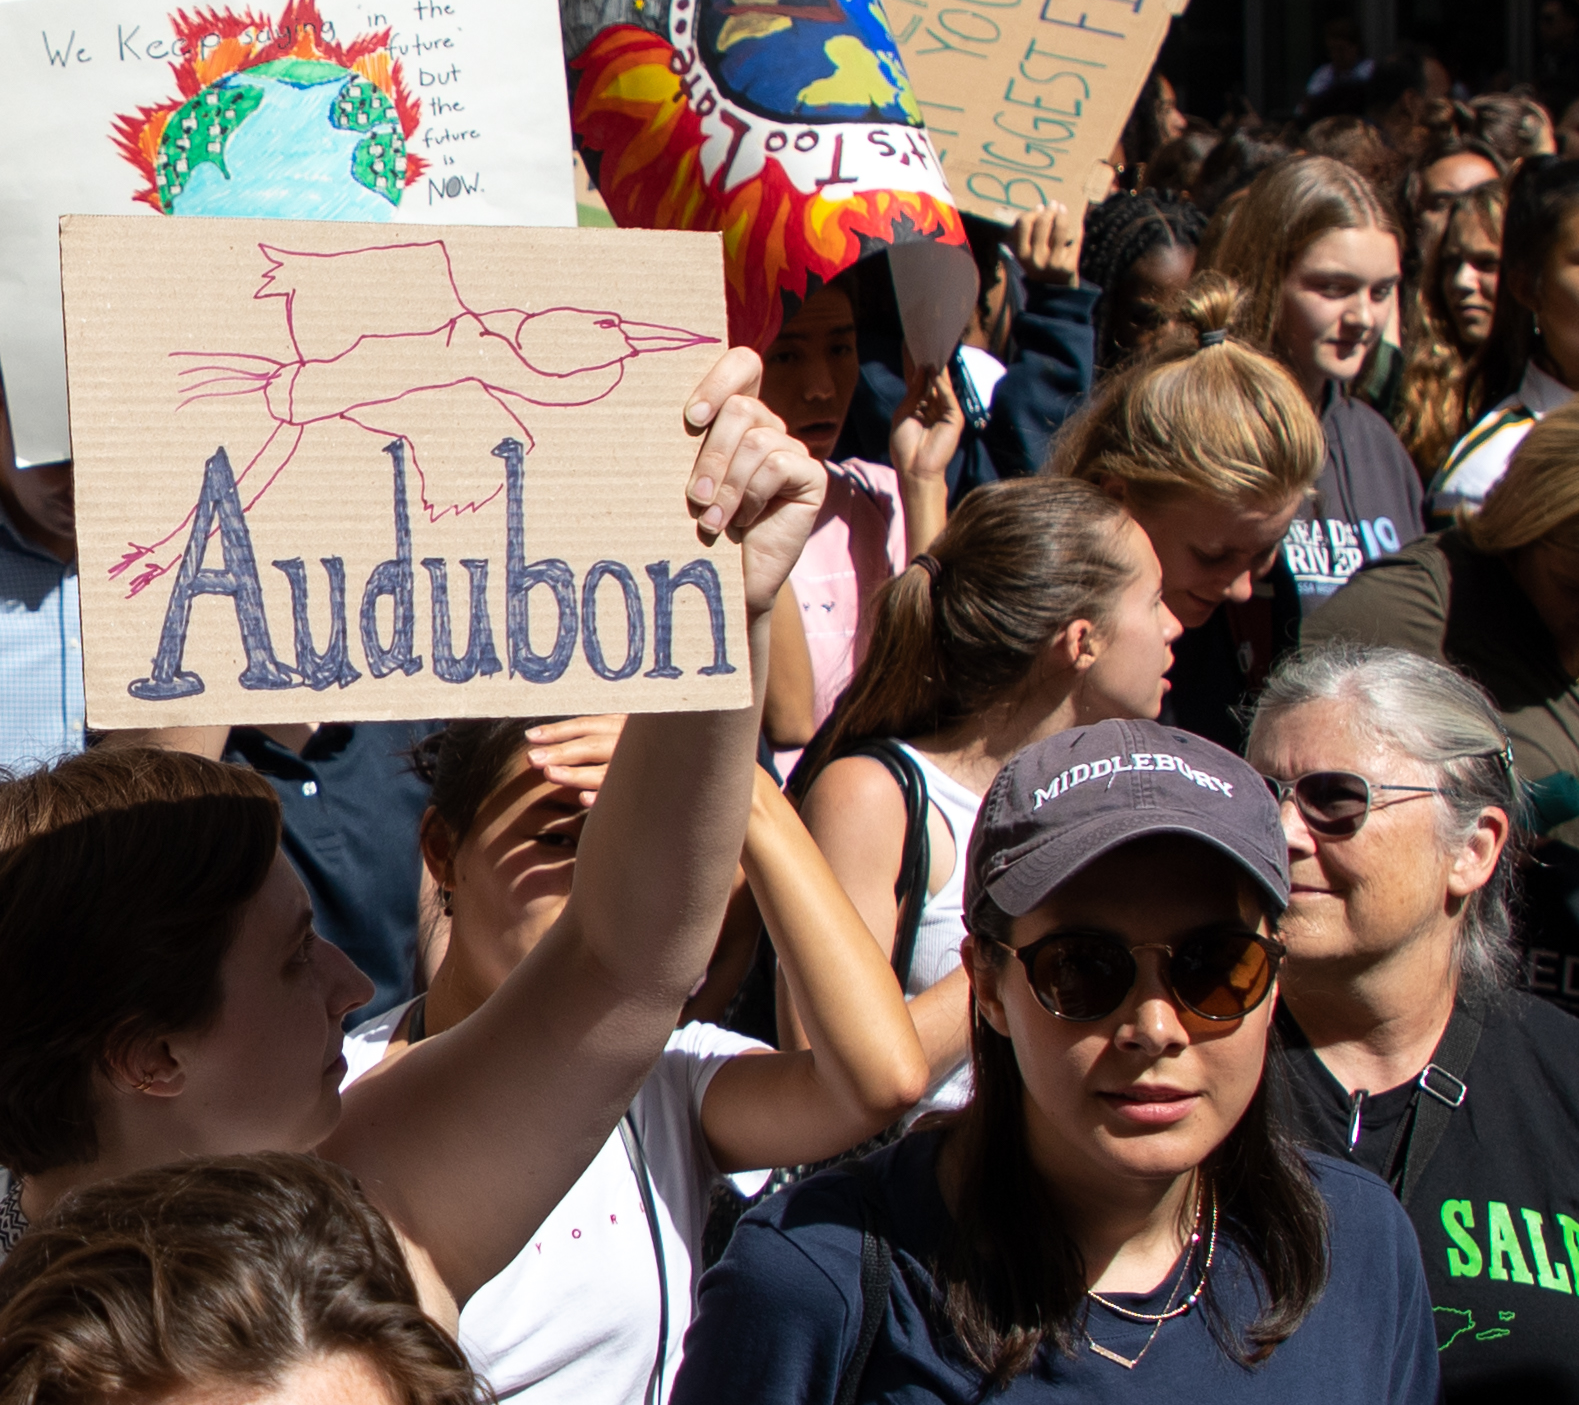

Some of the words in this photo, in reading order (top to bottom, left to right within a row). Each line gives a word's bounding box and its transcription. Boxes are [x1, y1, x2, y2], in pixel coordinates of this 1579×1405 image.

[42, 29, 92, 69] We
[240, 13, 337, 48] saying
[414, 0, 456, 22] the
[418, 66, 463, 88] but
[429, 96, 466, 117] the
[967, 39, 1107, 212] BIGGEST
[421, 125, 482, 149] future
[442, 152, 456, 166] is
[127, 436, 738, 701] Audubon
[1031, 752, 1236, 813] MIDDLEBURY
